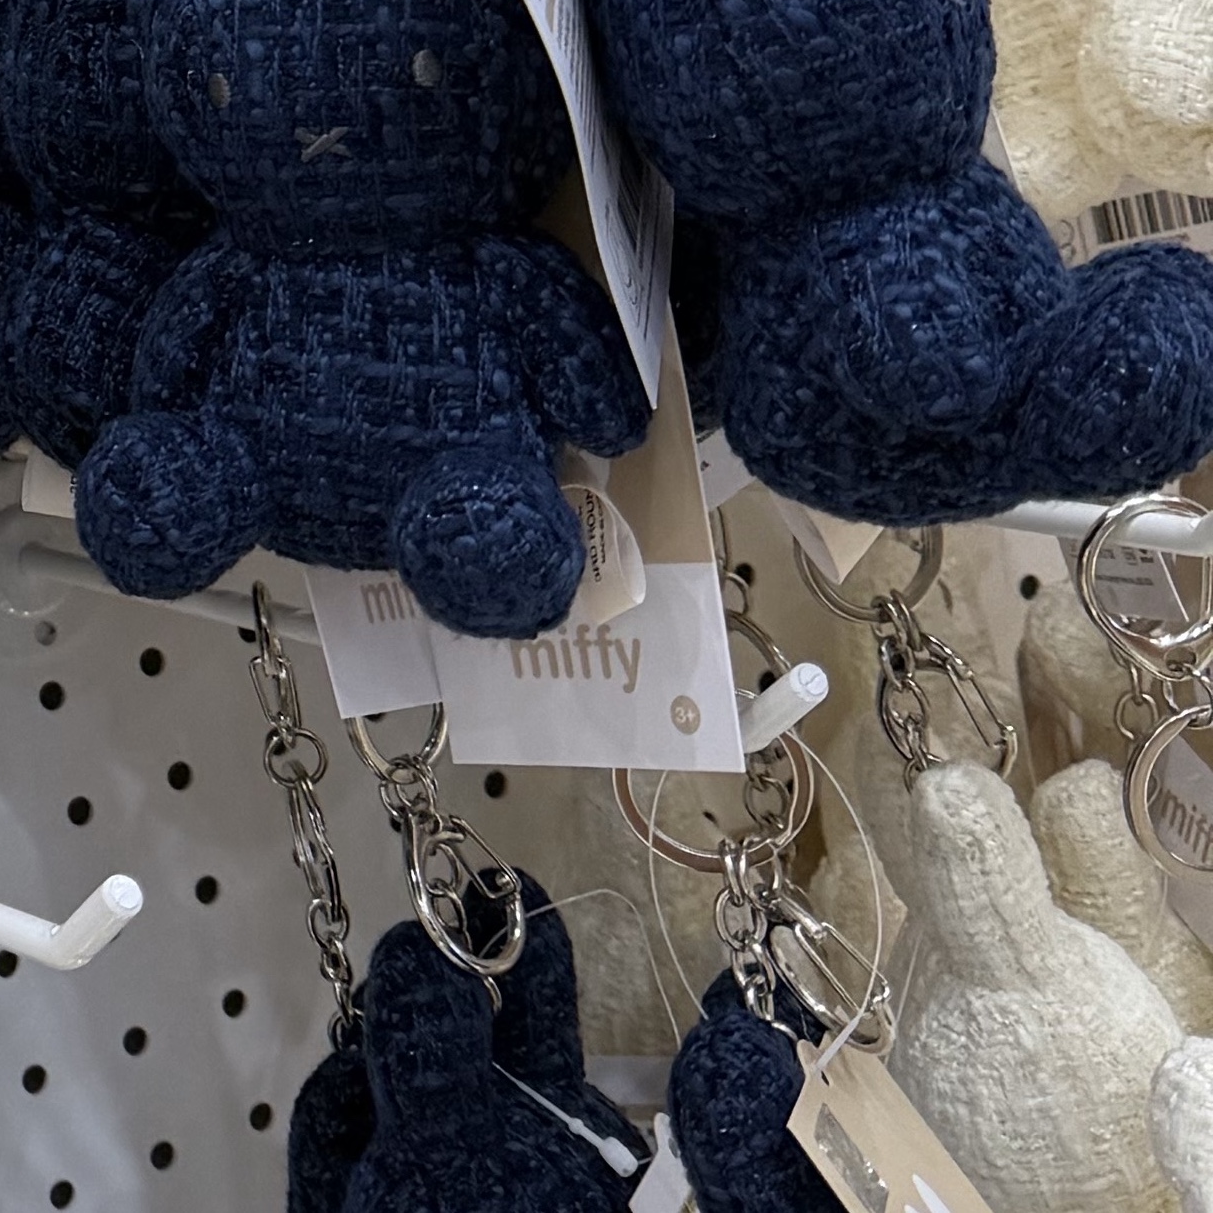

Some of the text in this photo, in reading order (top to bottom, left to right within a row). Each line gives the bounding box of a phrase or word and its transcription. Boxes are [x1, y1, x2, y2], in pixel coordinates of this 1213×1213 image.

[510, 624, 641, 694] miffy
[675, 705, 696, 724] 3+
[1160, 788, 1213, 865] miff
